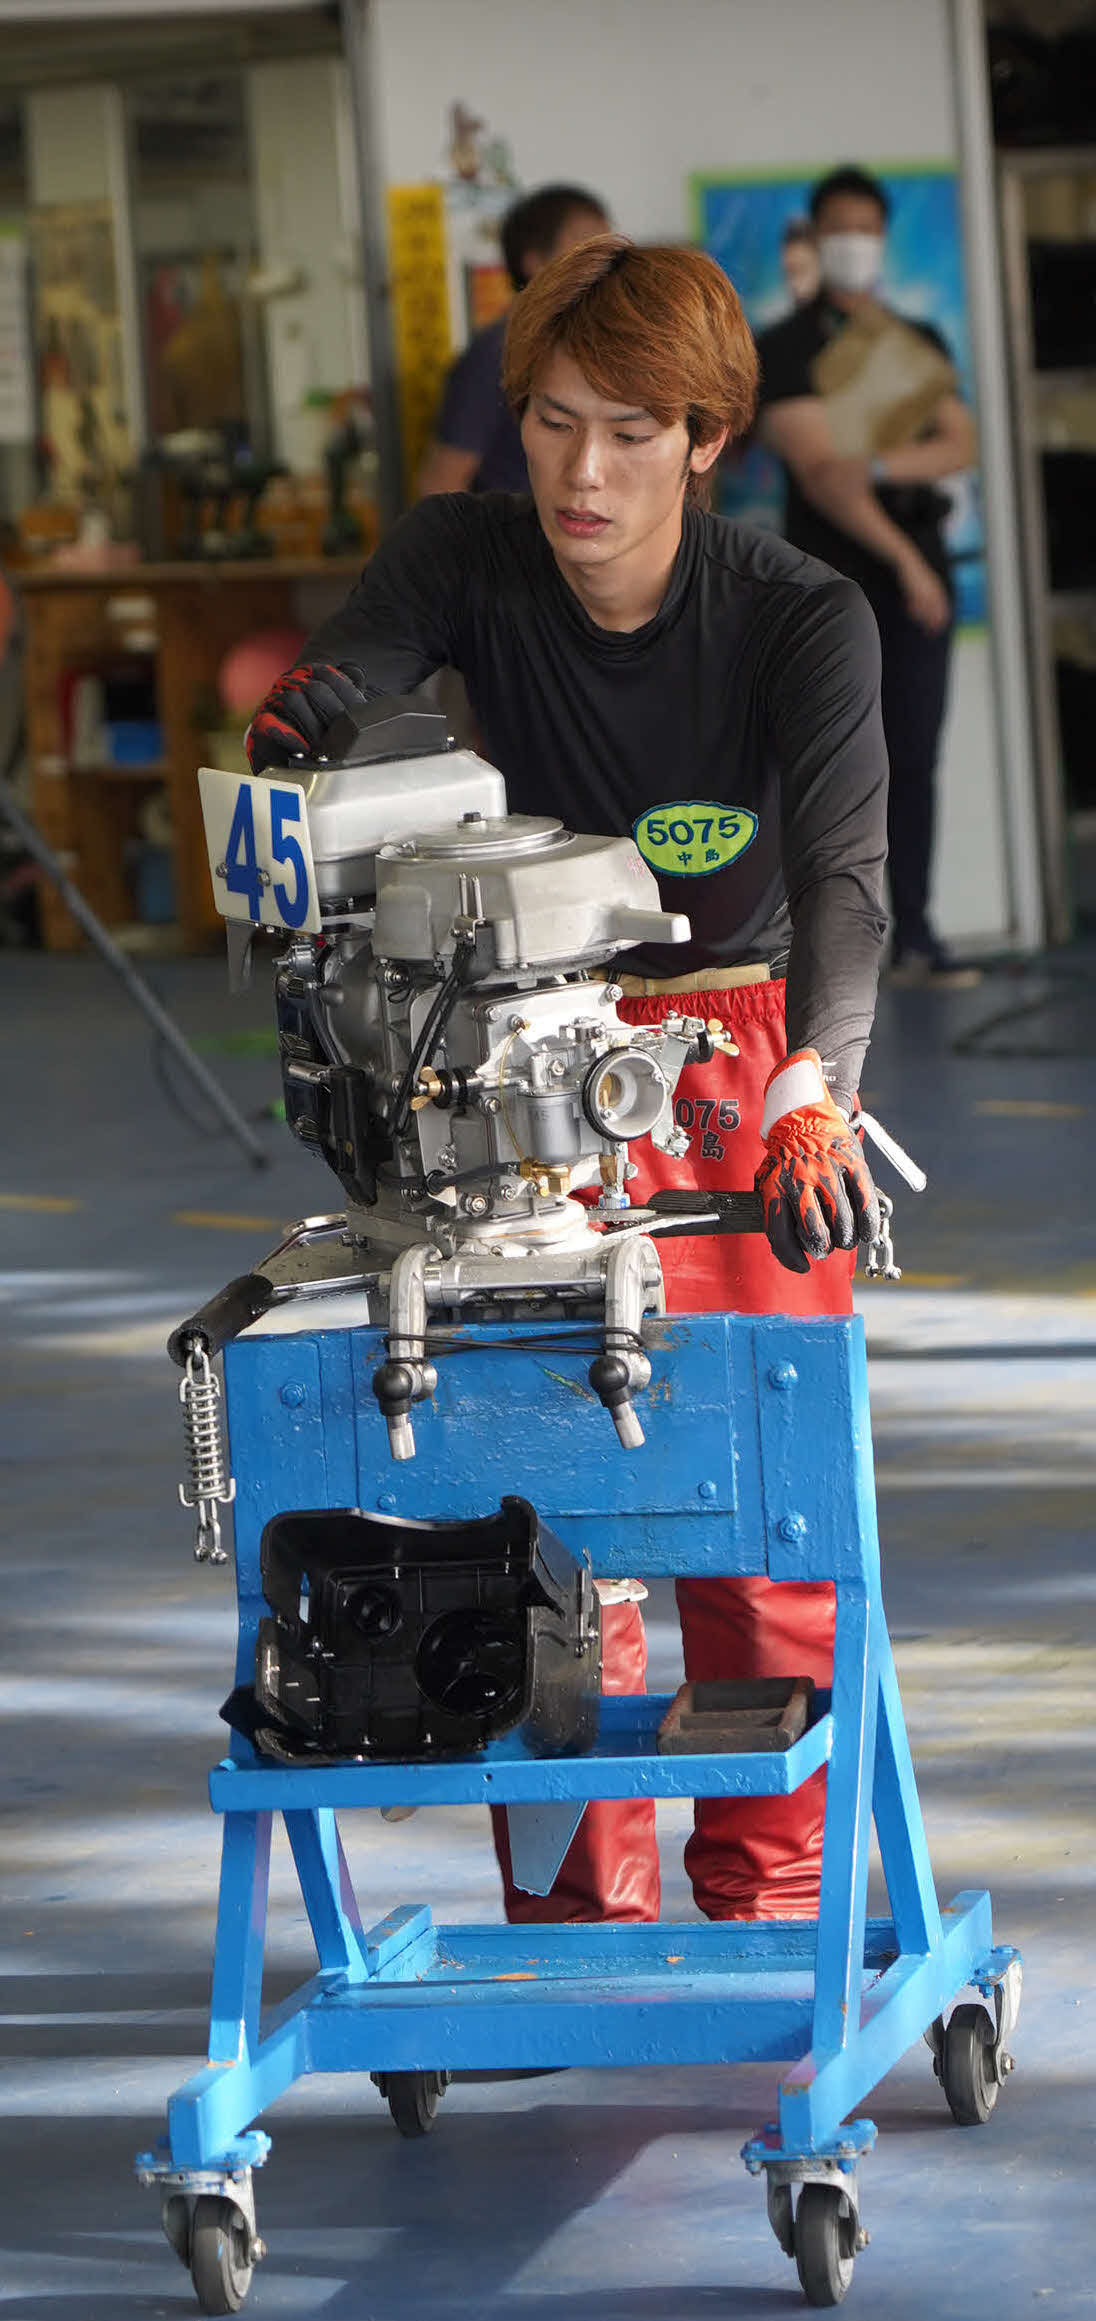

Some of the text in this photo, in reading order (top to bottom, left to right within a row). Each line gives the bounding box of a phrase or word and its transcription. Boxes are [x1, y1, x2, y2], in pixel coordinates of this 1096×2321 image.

[647, 814, 740, 845] 5075
[224, 784, 309, 928] 45
[675, 1097, 741, 1131] 075
[685, 1130, 725, 1160] 島
